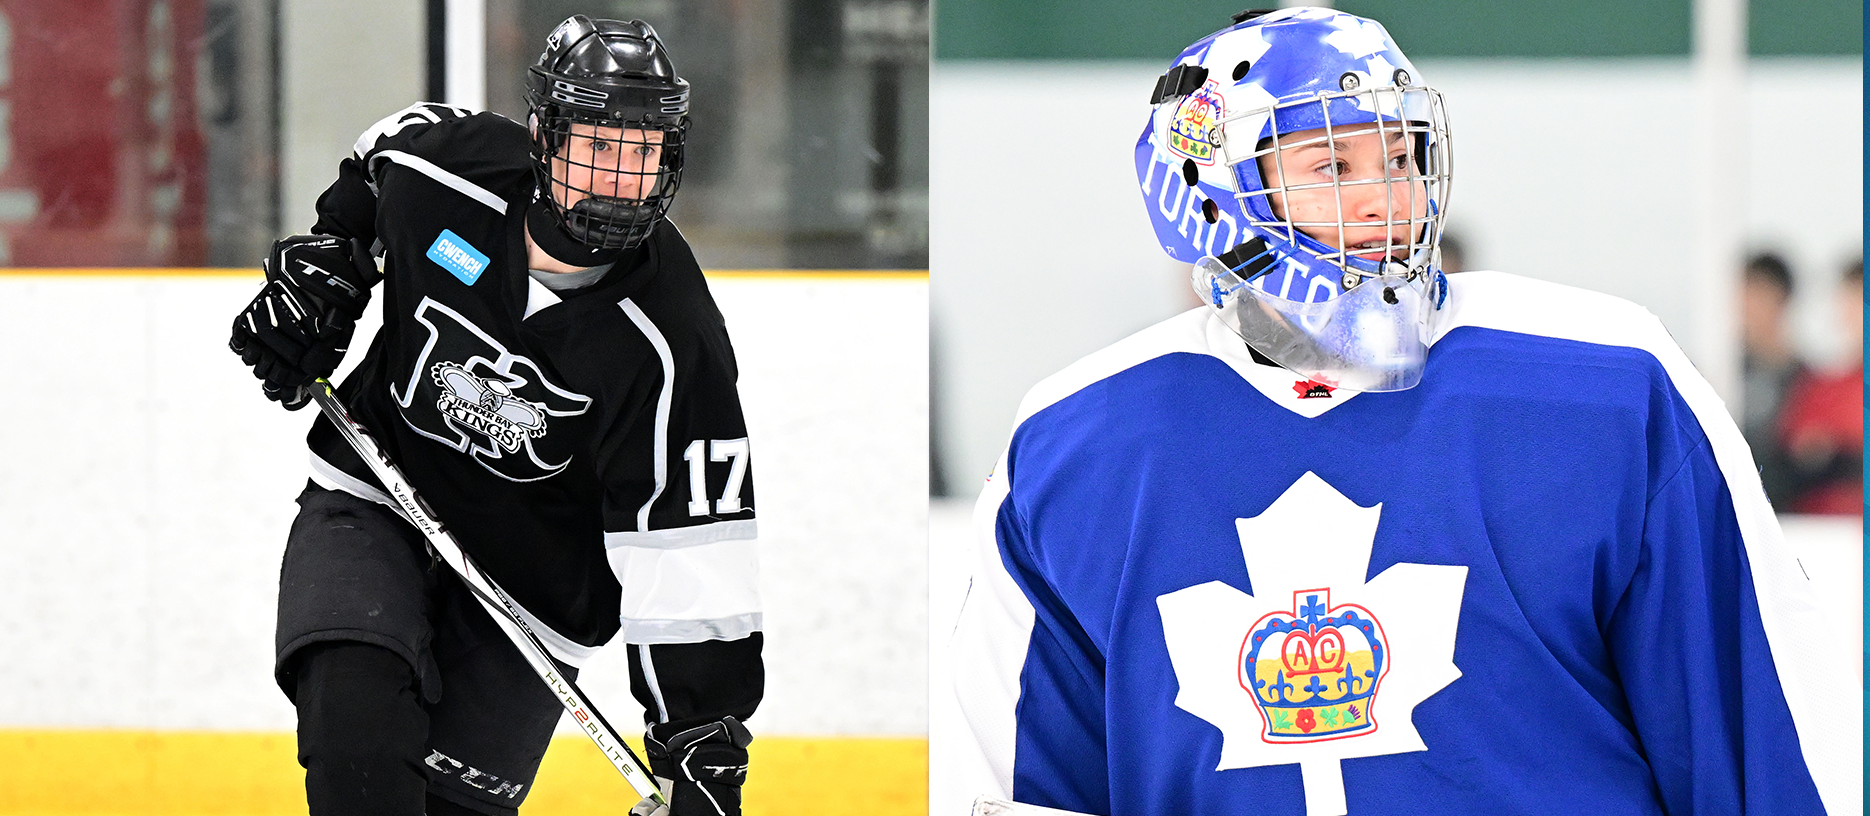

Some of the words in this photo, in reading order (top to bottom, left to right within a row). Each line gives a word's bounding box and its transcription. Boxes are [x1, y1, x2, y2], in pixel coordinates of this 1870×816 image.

[1142, 132, 1340, 334] TOROTO
[433, 250, 475, 279] HYDRATION
[437, 239, 483, 275] CWENCH
[443, 399, 516, 447] KINGS
[453, 397, 495, 420] THUNDER
[495, 416, 514, 430] BAY
[683, 436, 750, 517] 17
[398, 494, 435, 535] BAUER
